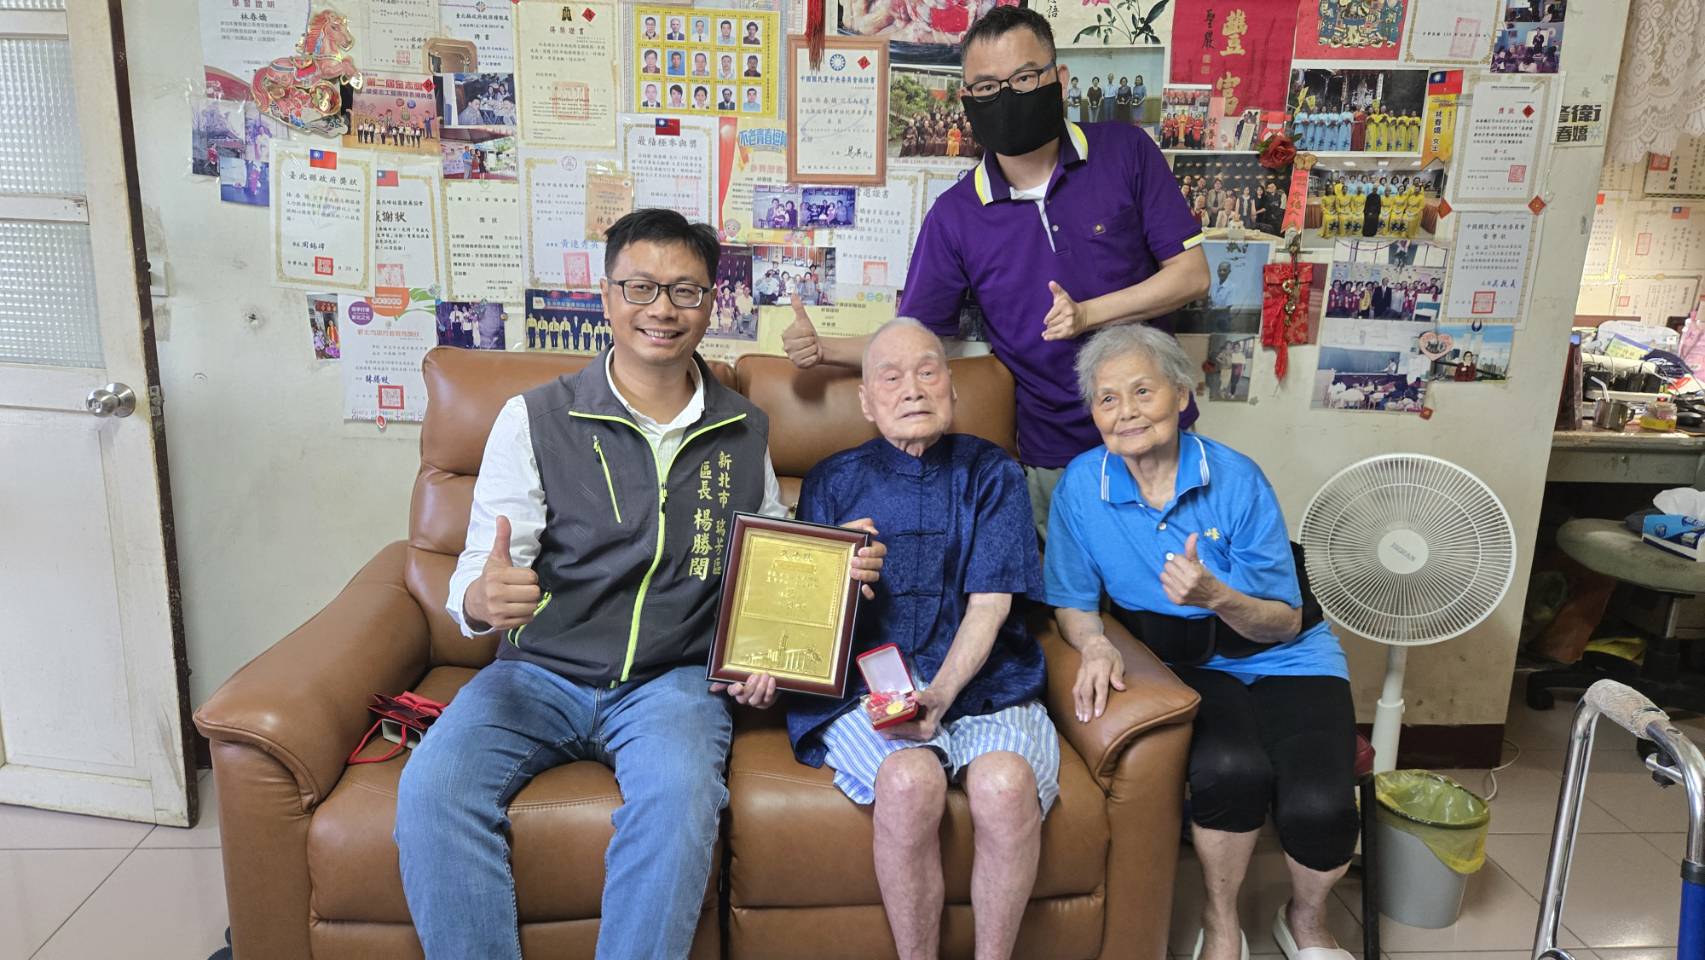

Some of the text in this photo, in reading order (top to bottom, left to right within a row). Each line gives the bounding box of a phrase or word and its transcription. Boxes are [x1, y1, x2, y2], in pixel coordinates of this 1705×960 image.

[688, 460, 714, 581] 區長 楊勝閔
[712, 450, 733, 575] 新北市 瑞芳區
